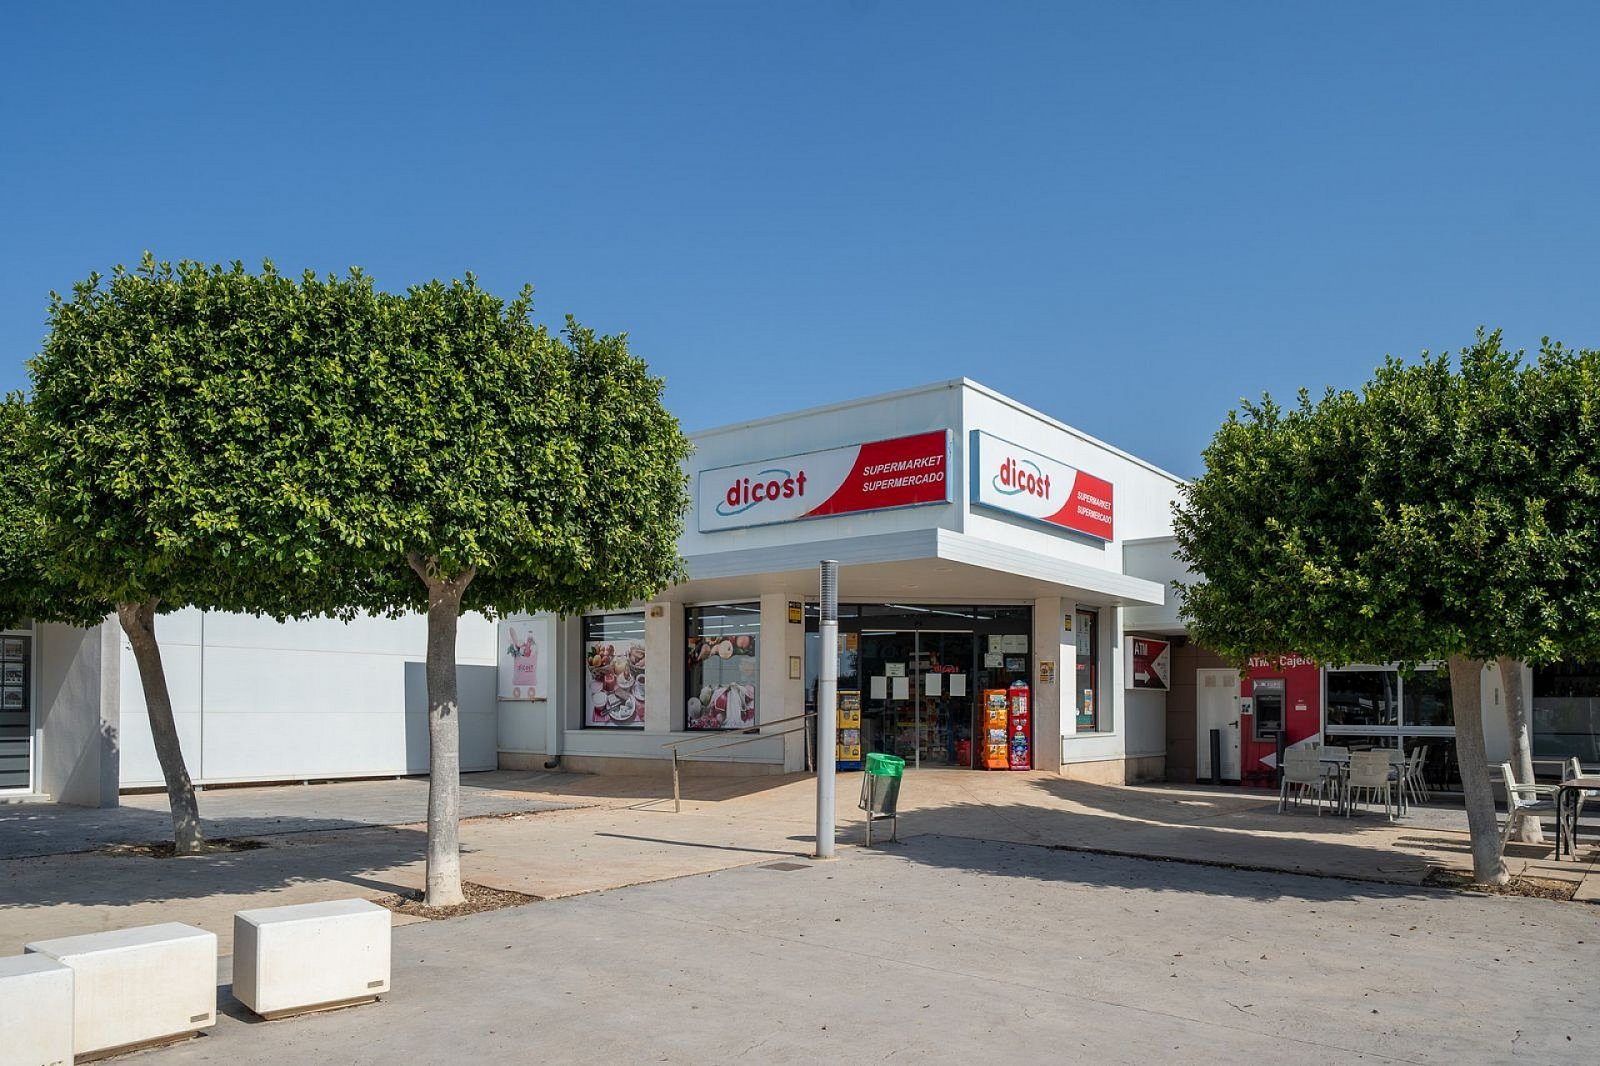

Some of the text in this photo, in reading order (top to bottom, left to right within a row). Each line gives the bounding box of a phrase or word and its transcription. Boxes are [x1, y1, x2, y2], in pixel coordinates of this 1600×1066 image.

[863, 455, 943, 476] SUPERMARKET
[727, 470, 807, 506] dicost
[862, 471, 944, 492] SUPERMERCADO
[1000, 457, 1050, 500] dicost
[1077, 491, 1111, 510] SUPERMARKET
[1077, 505, 1112, 524] SUPERMERCADO
[1134, 641, 1148, 656] ATM
